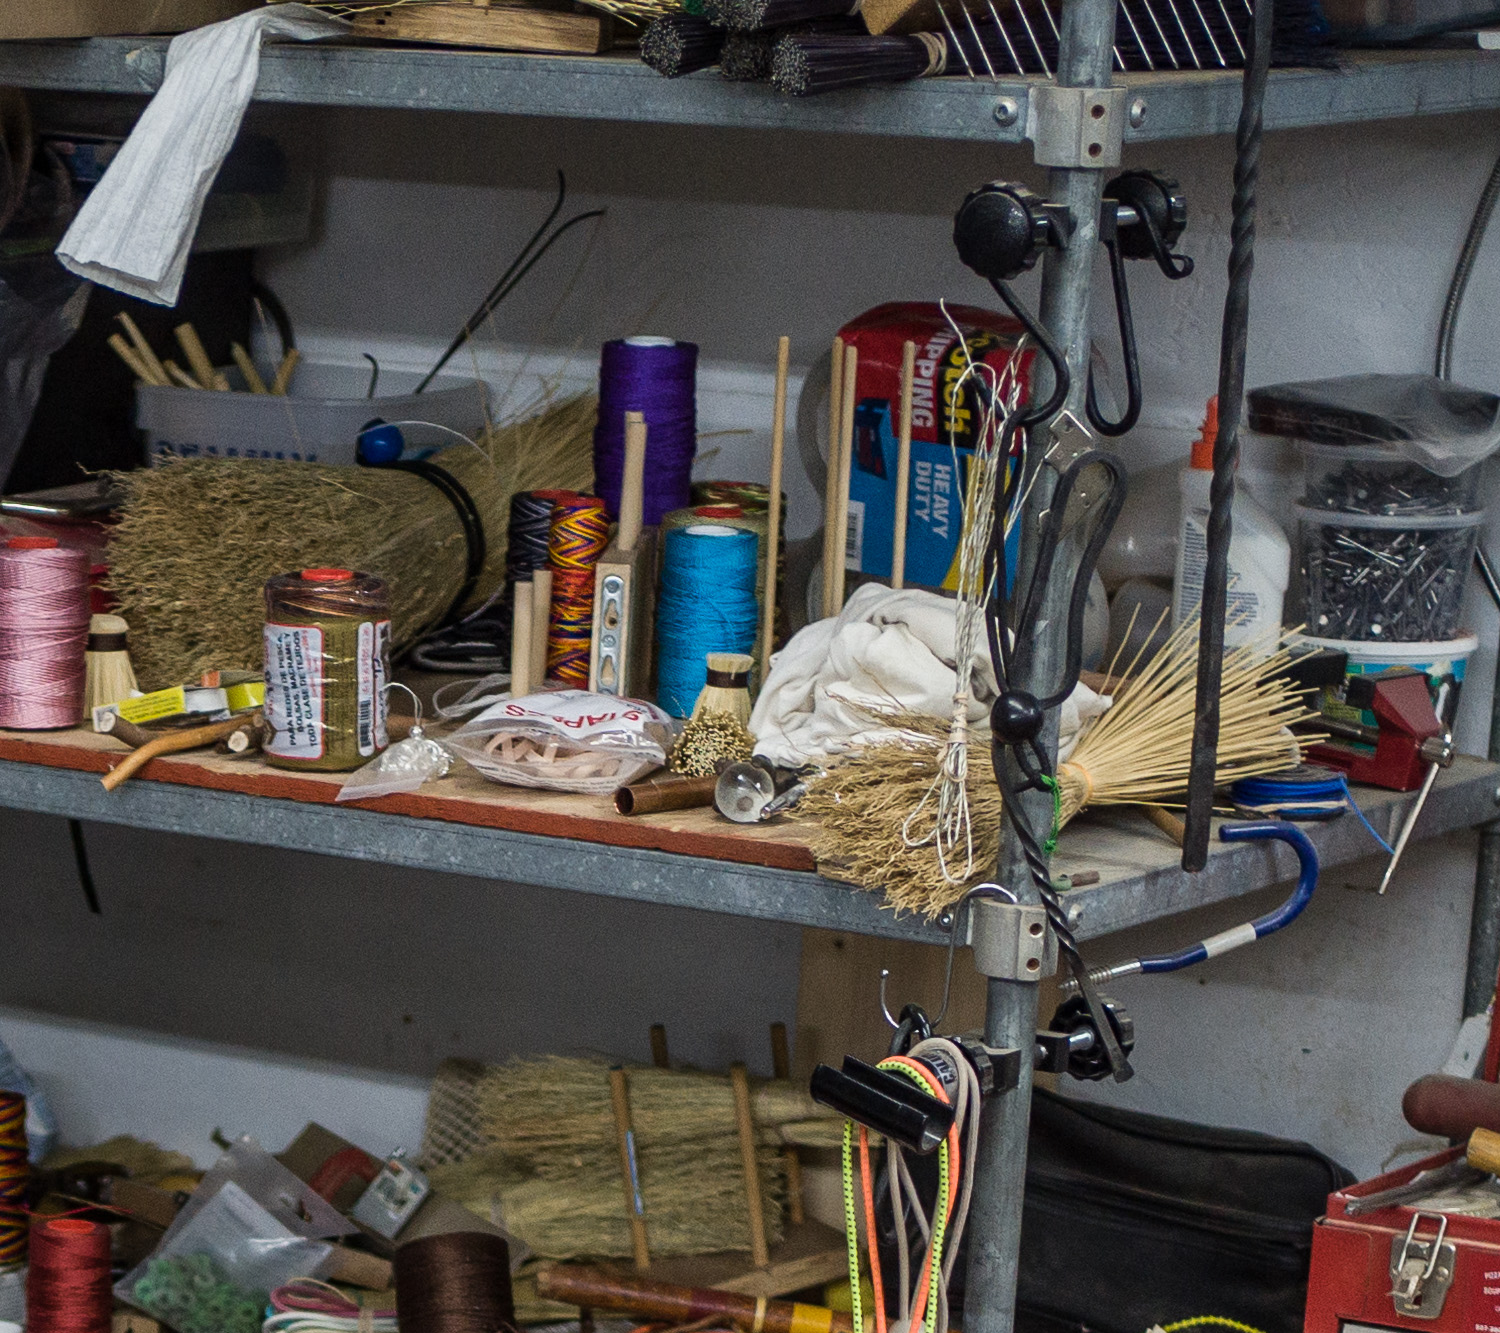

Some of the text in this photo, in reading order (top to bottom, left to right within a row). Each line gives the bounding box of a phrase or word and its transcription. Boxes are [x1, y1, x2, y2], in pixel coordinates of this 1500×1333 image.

[915, 461, 932, 522] DUTY
[932, 463, 952, 539] HEAVY
[302, 690, 313, 722] CLASE
[286, 718, 297, 746] PARA
